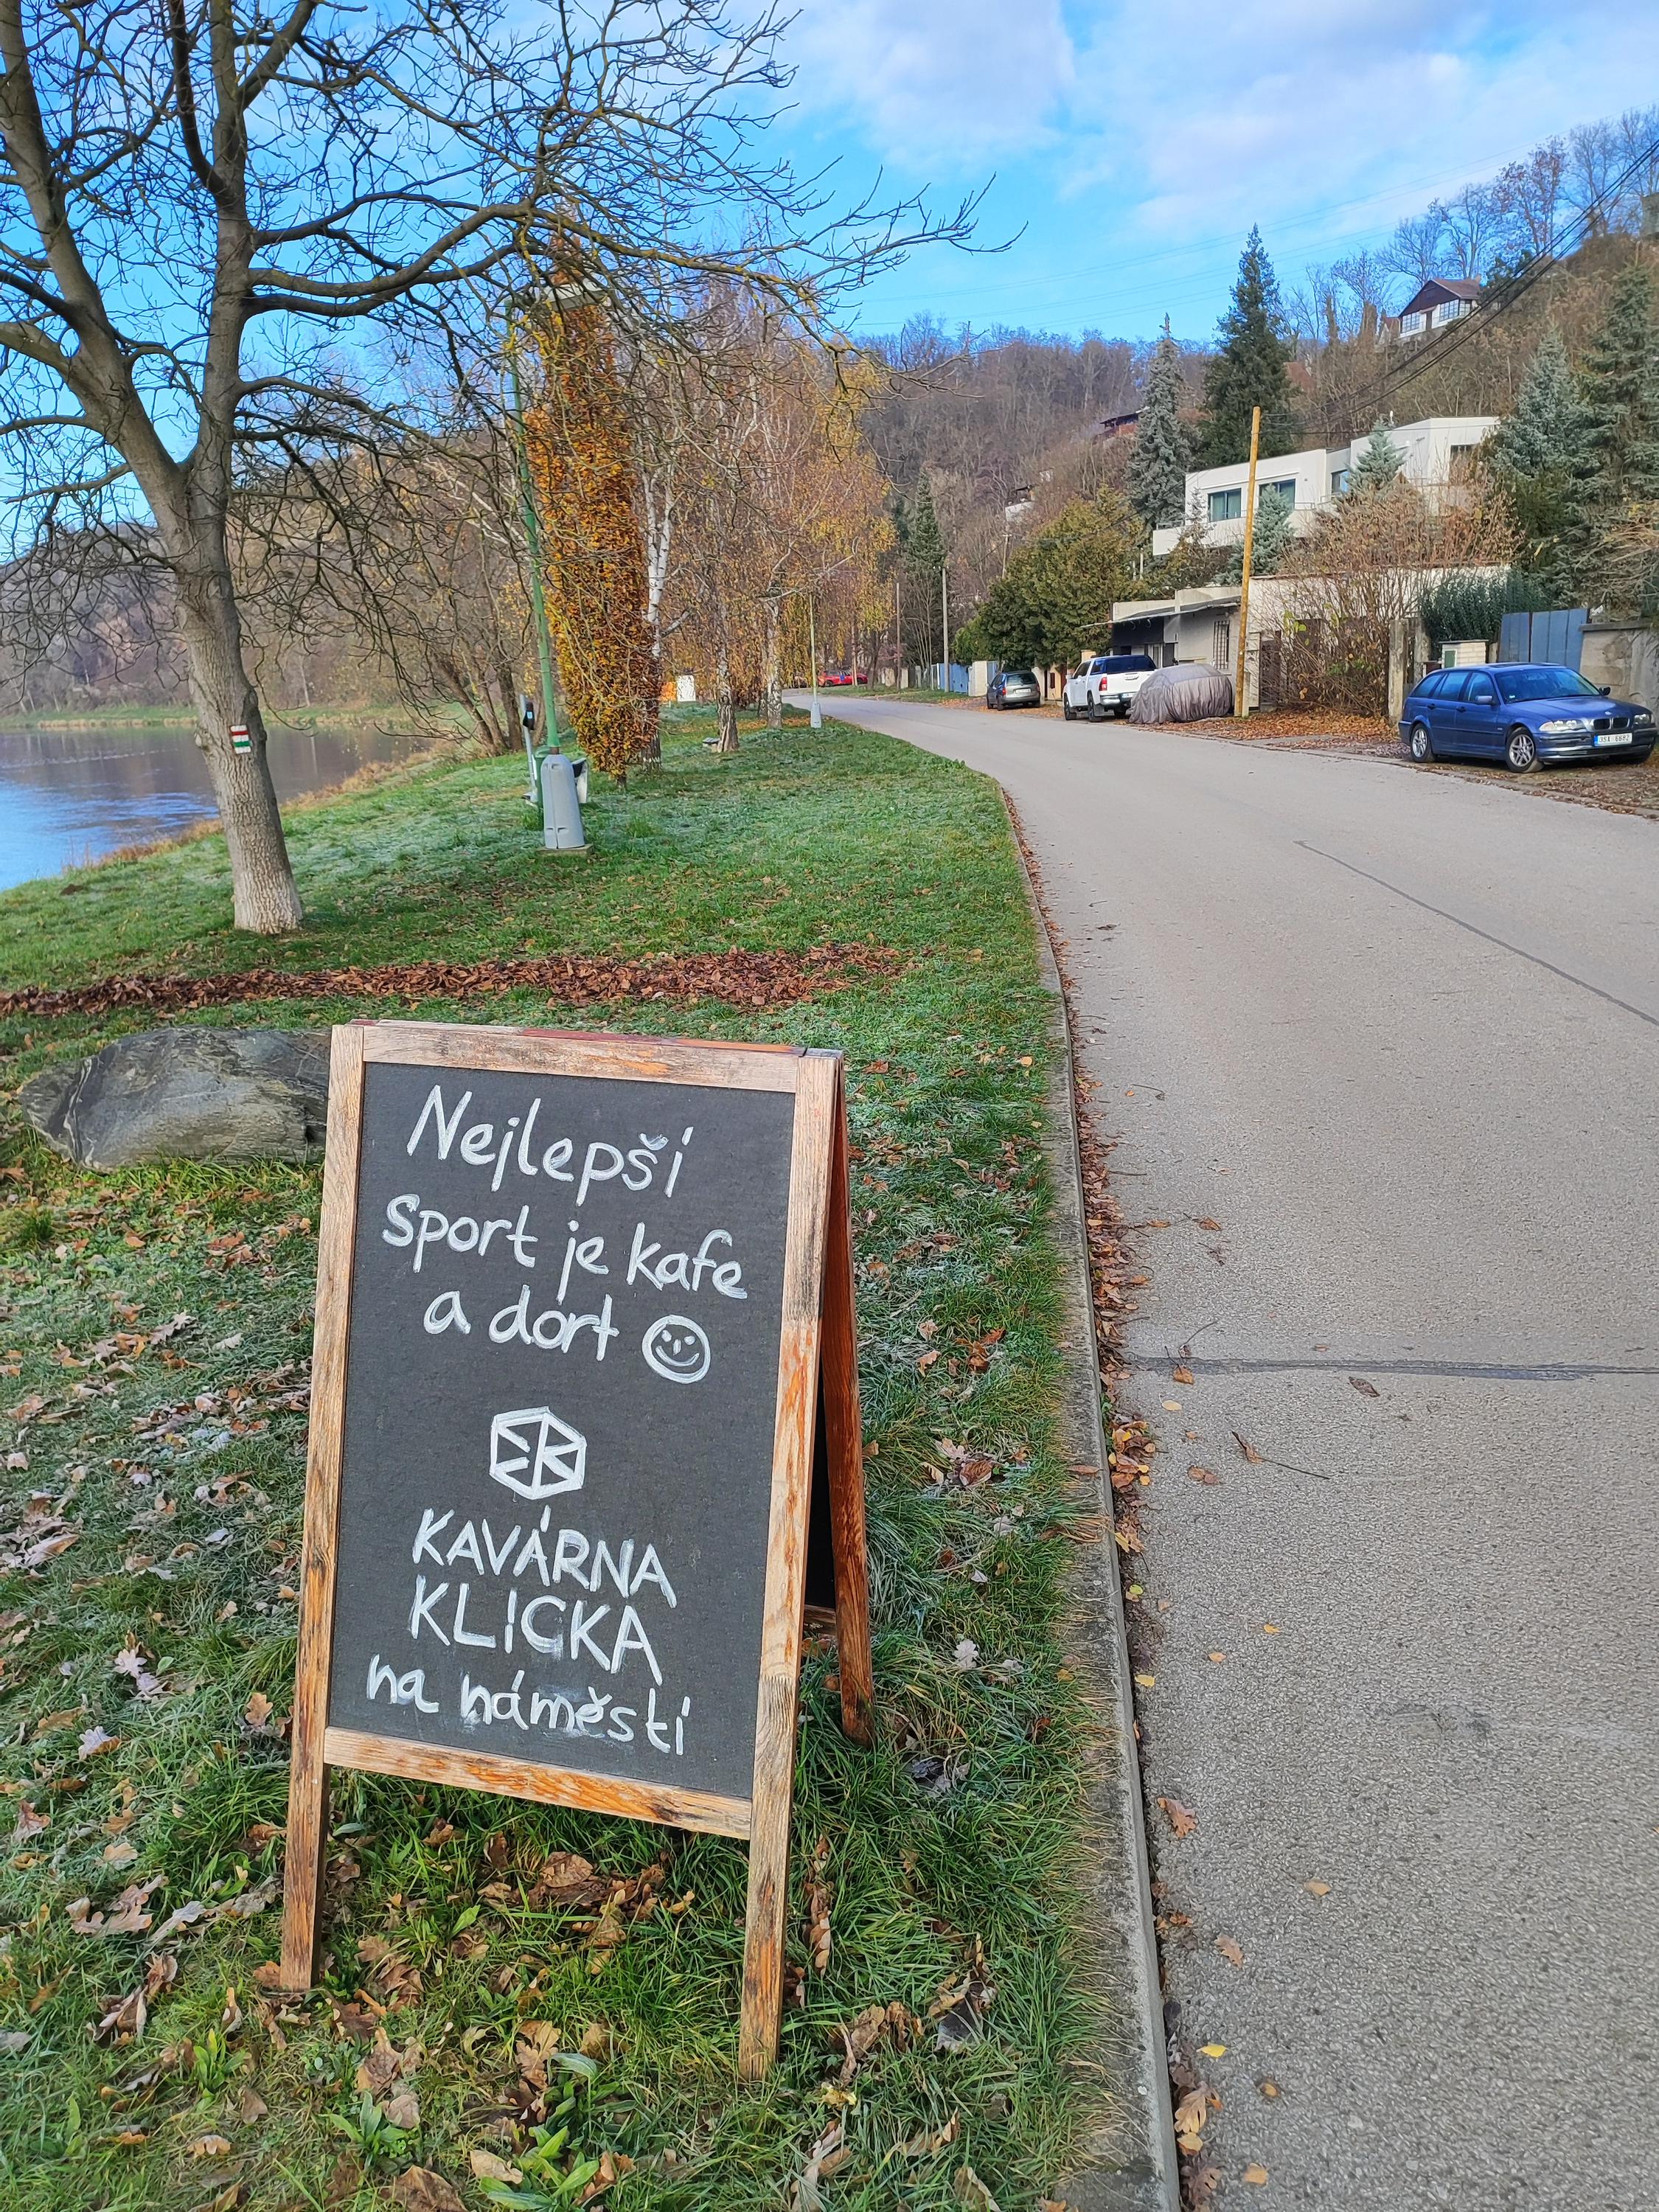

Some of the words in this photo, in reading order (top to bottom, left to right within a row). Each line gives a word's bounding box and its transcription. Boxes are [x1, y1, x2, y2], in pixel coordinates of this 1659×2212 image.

[406, 1084, 695, 1207] Nejlepší
[555, 1220, 610, 1306] je
[625, 1221, 748, 1300] kafe
[422, 1290, 472, 1335] a
[488, 1284, 620, 1362] dort
[411, 1504, 678, 1609] KAVÁRNA
[366, 1653, 440, 1714] na
[458, 1669, 692, 1756] náměstí
